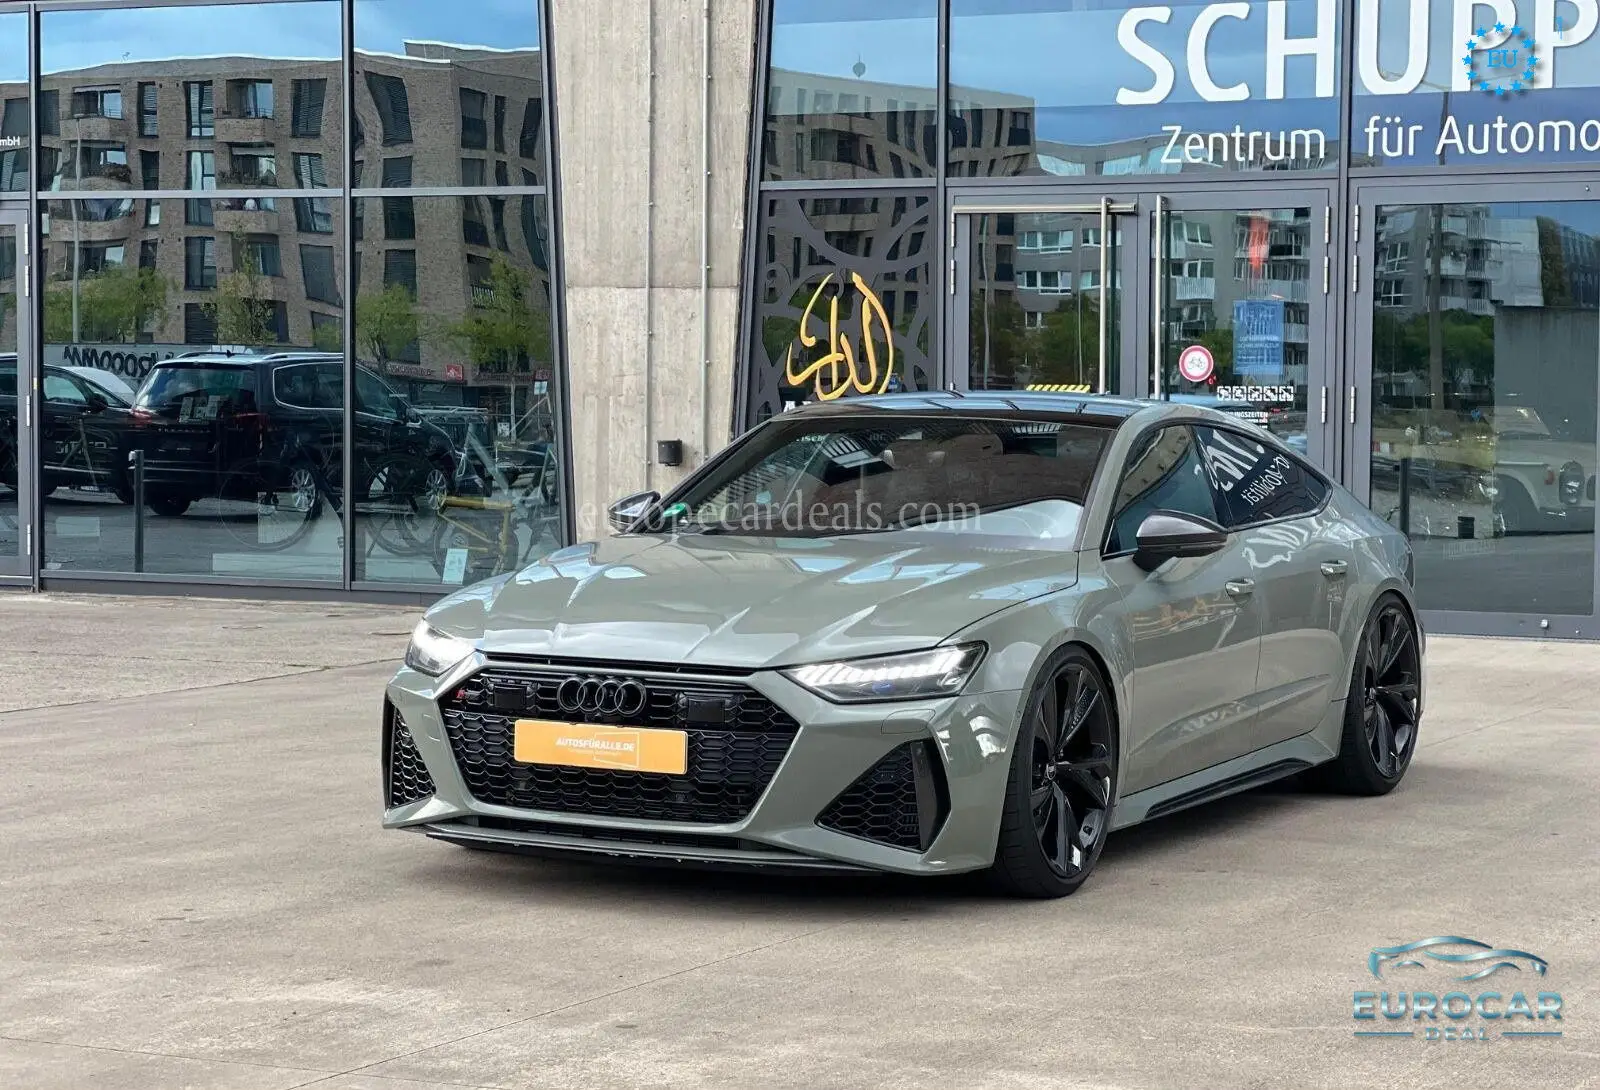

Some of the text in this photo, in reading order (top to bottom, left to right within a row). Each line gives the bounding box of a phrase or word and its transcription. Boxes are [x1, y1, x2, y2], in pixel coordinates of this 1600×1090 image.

[1160, 115, 1600, 163] Zentrum für Automo
